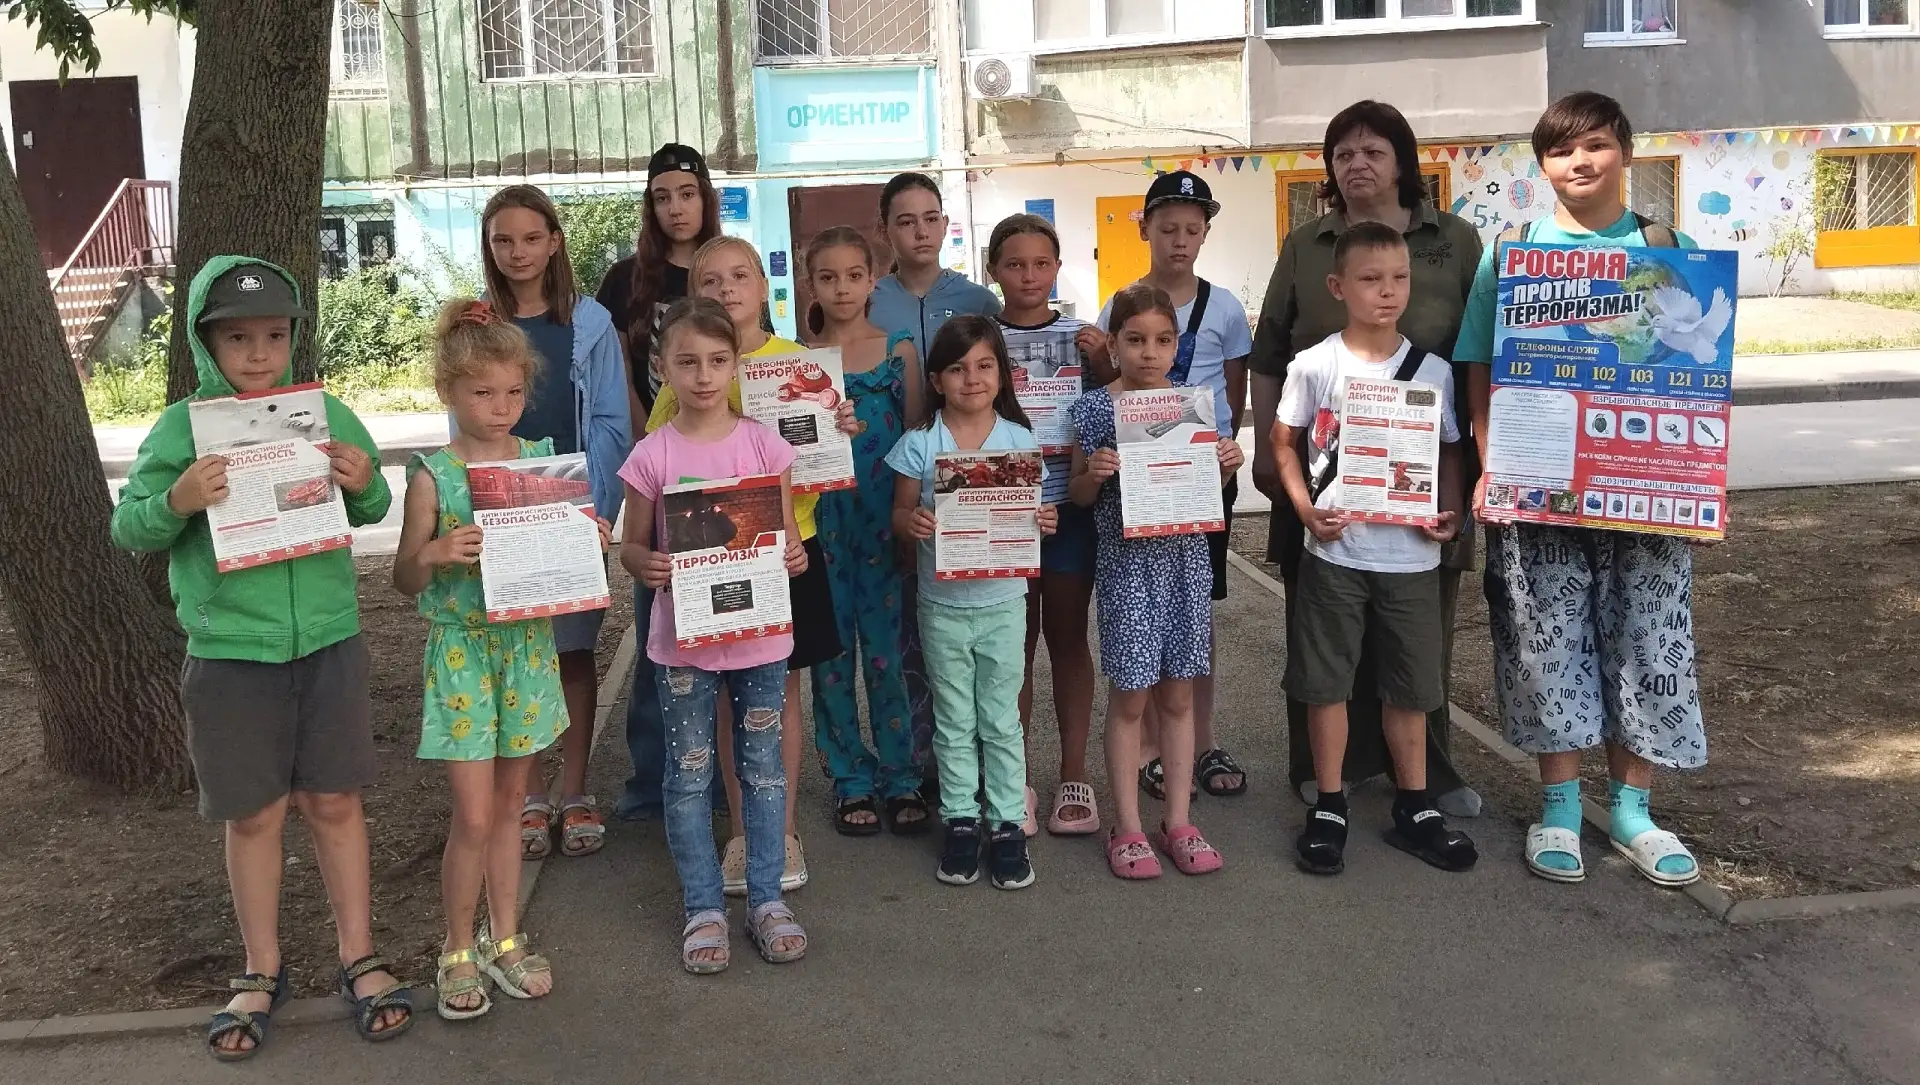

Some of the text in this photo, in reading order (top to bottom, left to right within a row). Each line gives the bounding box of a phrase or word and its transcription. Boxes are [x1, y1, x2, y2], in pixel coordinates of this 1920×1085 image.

[787, 102, 910, 128] ОРИЕНТИР
[1507, 248, 1627, 280] РОССИЯ
[1513, 278, 1591, 304] ПРОТИВ
[1504, 294, 1641, 326] ТЕРРОРИЗМА!
[1515, 342, 1600, 355] ТЕЛЕФОНЫ СЛУЖБ
[745, 357, 801, 370] ТЕЛЕФОННЫЙ
[745, 362, 820, 380] ТЕРРОРИЗМ
[1509, 361, 1532, 376] 112
[1554, 364, 1577, 379] 101
[1592, 367, 1617, 382] 102
[1630, 369, 1654, 384] 103
[1669, 372, 1692, 387] 121
[1703, 374, 1727, 388] 123
[1349, 383, 1399, 394] АЛГОРИТМ
[1120, 395, 1181, 407] ОКАЗАНИЕ
[1348, 391, 1397, 402] ДЕЙСТВИЙ
[1593, 396, 1725, 412] ВЗРЫВООПАСНЫЕ ПРЕДМЕТЫ
[1121, 411, 1182, 423] ПОМОЩИ
[1347, 403, 1372, 415] ПРИ
[1376, 405, 1425, 418] ТЕРАКТЕ
[228, 449, 296, 466] ОПАСНОСТЬ
[1613, 455, 1638, 463] СЛУЧАЕ
[1648, 458, 1685, 467] КАСАЙТЕСЬ
[1590, 475, 1668, 489] ПОДОЗРИТЕЛЬНЫЕ
[1669, 482, 1717, 494] ПРЕДМЕТЫ
[958, 494, 1035, 502] БЕЗОПАСНОСТЬ
[481, 505, 568, 518] АНТИТЕРРОРИСТИЧЕСКАЯ
[482, 511, 569, 526] БЕЗОПАСНОСТЬ
[676, 549, 759, 570] ТЕРРОРИЗМ
[1532, 542, 1569, 566] 200
[1529, 636, 1557, 654] 6AM
[1639, 673, 1678, 697] 400
[1560, 688, 1577, 700] 100
